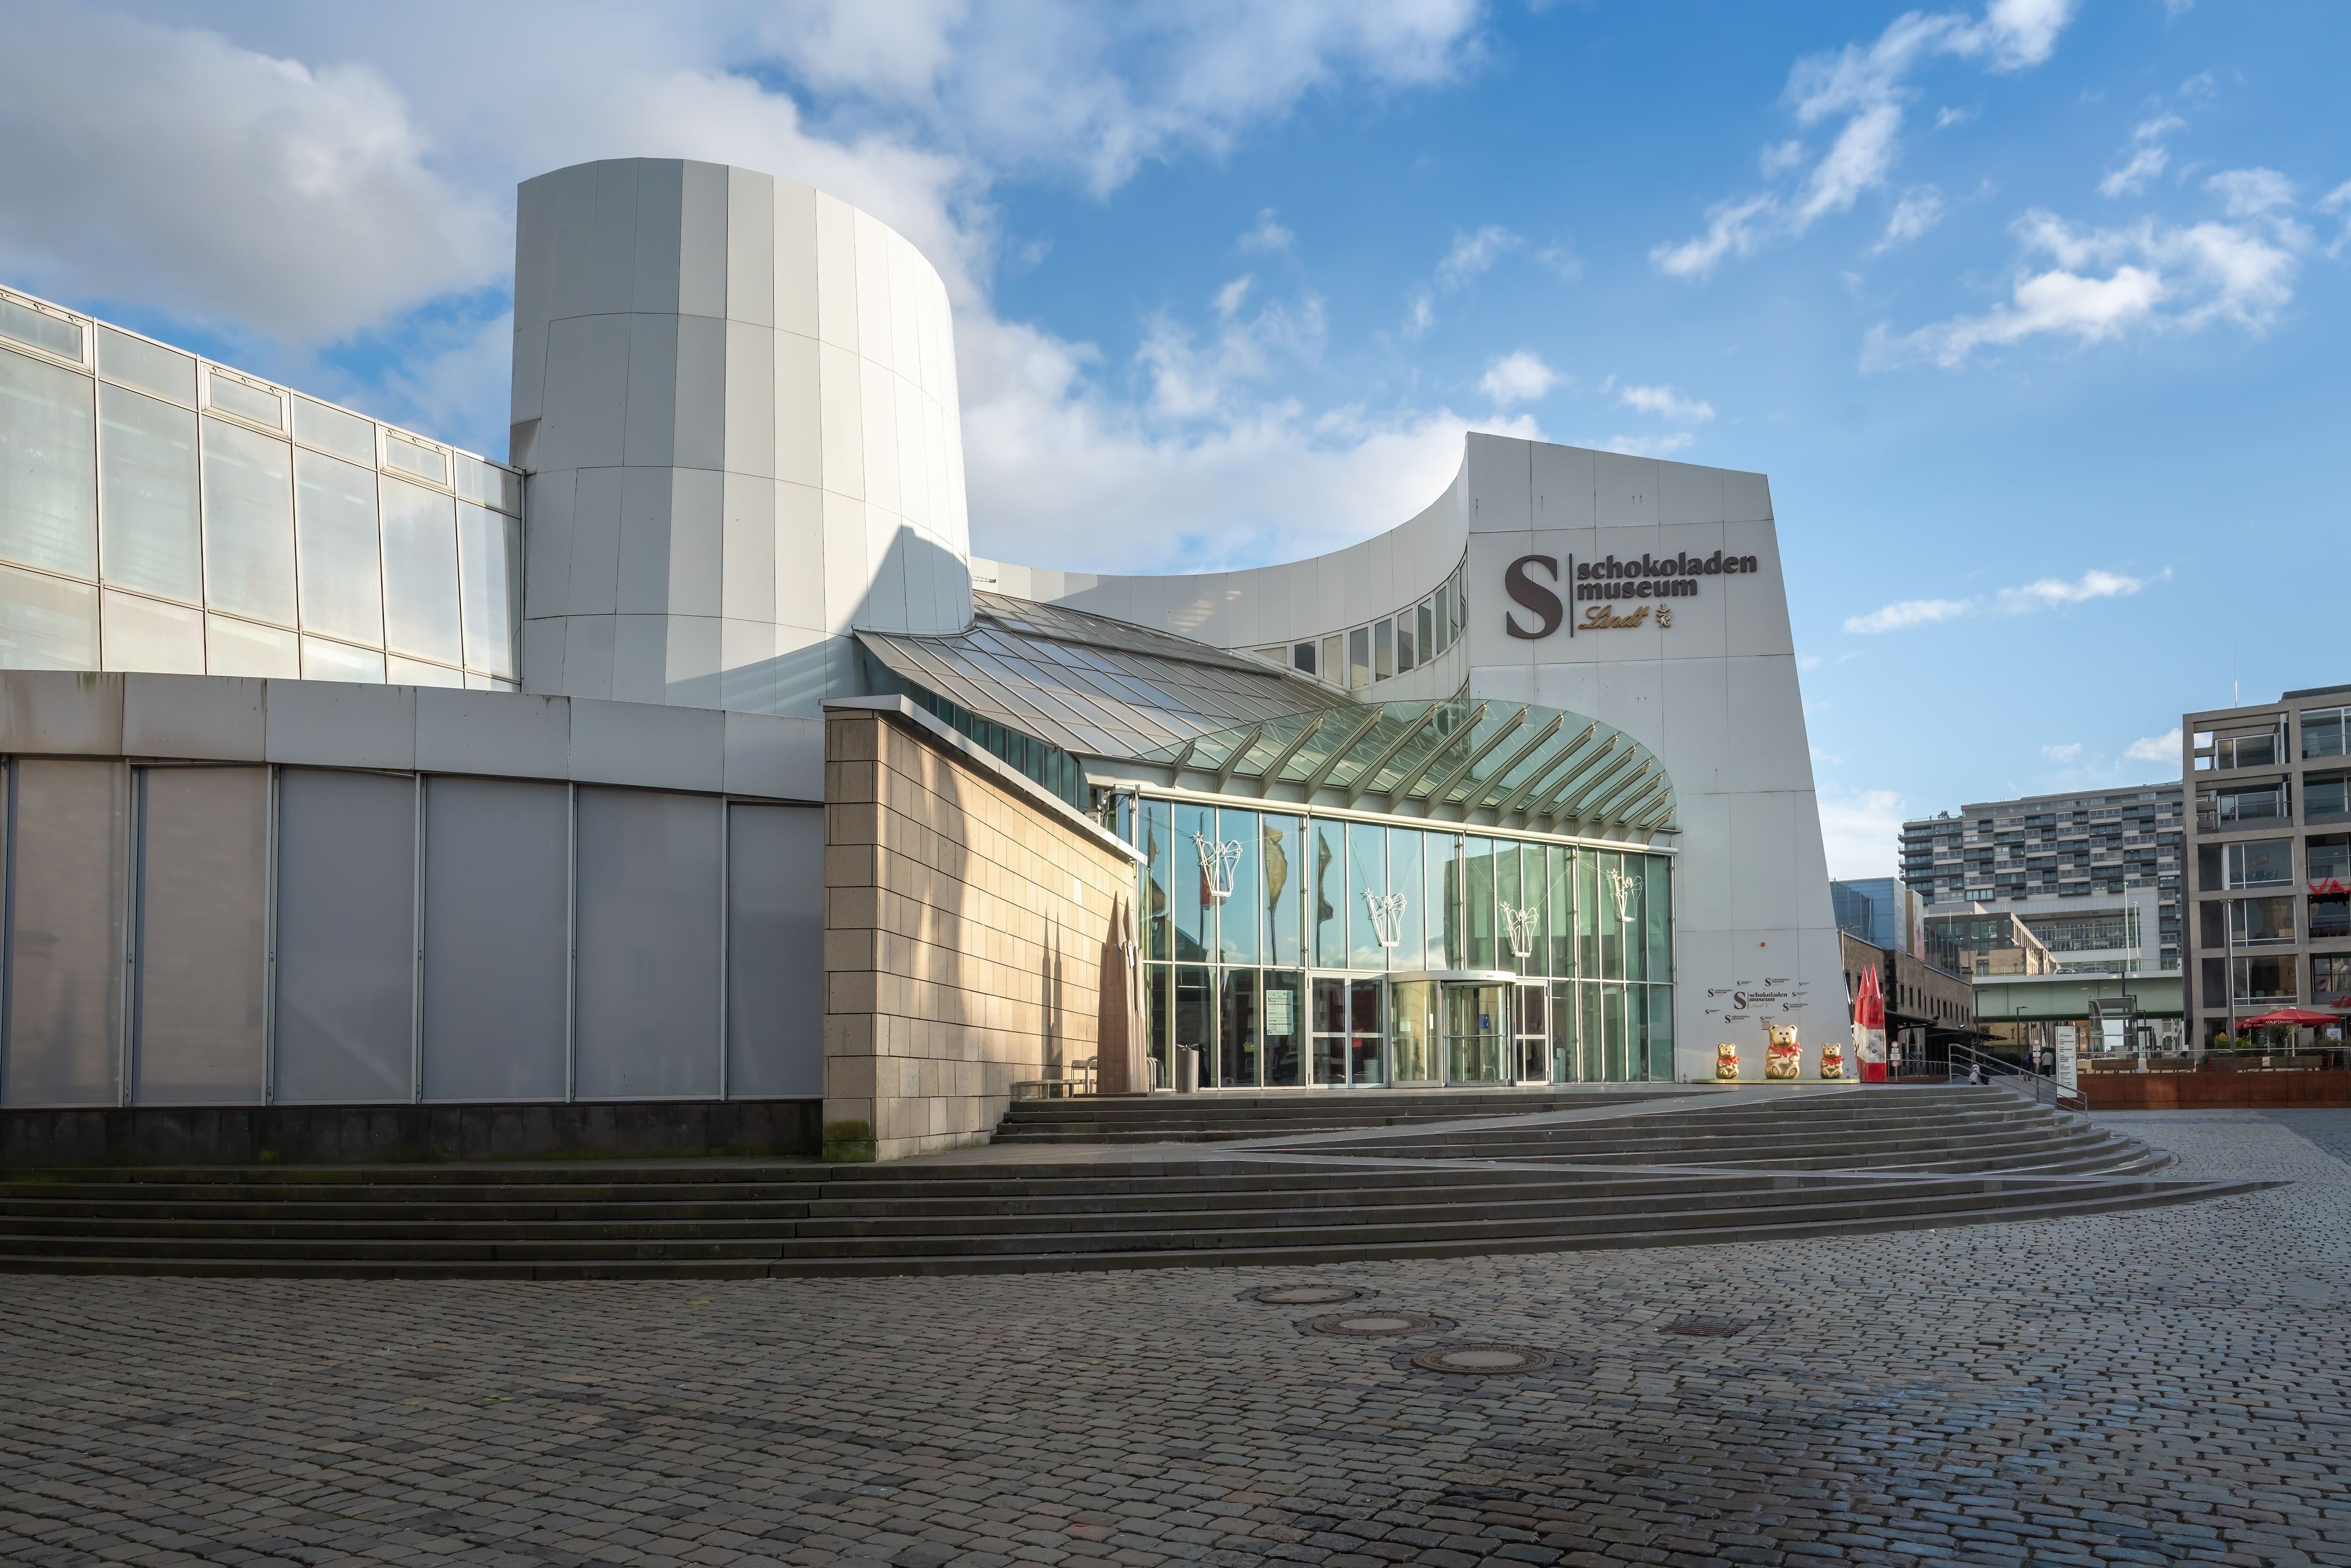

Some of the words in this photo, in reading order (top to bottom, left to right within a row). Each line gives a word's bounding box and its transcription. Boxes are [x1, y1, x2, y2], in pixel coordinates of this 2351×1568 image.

[1577, 550, 1757, 580] schokoladen
[1504, 554, 1563, 639] S
[1577, 577, 1698, 600] museum
[1578, 604, 1649, 629] Lindt
[2308, 877, 2351, 895] VA
[1764, 978, 1771, 987] S
[1708, 988, 1714, 997] S
[1733, 991, 1747, 1010] S
[1782, 1003, 1789, 1011] S
[1725, 1015, 1731, 1024] S
